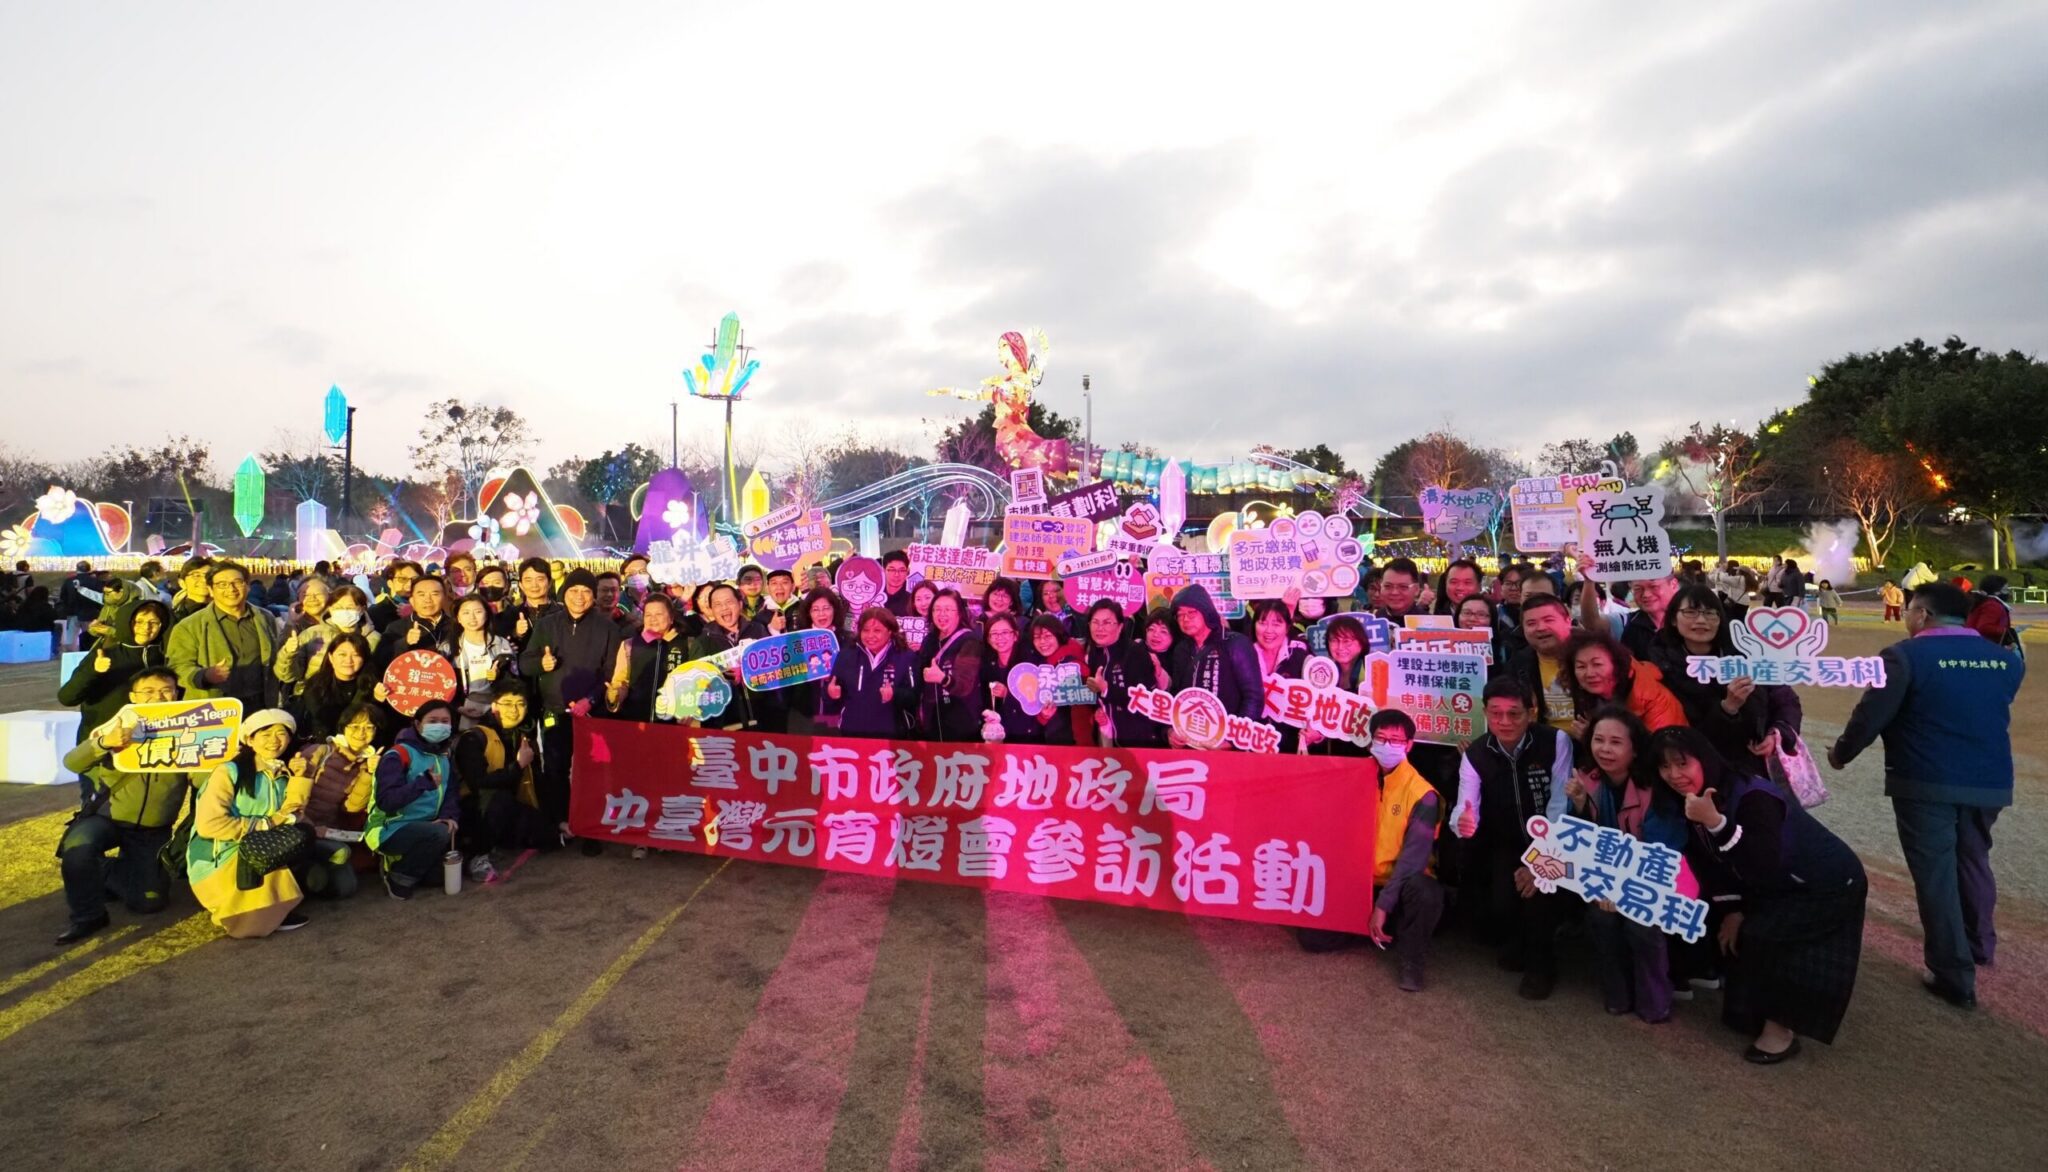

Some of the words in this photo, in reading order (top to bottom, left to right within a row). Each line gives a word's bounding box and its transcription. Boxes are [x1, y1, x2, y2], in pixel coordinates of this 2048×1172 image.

[1560, 474, 1600, 489] Easy
[1051, 485, 1118, 518] 重劃科
[1423, 491, 1493, 509] 清水地政
[1010, 519, 1087, 534] 建物第一次登記
[651, 537, 701, 564] 龍井
[774, 540, 824, 558] 區段徵收
[909, 546, 988, 567] 指定送達處所
[1016, 545, 1044, 557] 辦理
[1234, 539, 1296, 556] 多元繳納
[1593, 535, 1660, 558] 無人機
[680, 559, 736, 584] 地政
[1013, 559, 1048, 573] 最快速
[1239, 555, 1303, 571] 地政規費
[1595, 558, 1661, 574] 測繪新紀元
[1078, 576, 1130, 593] 智慧水湳
[1237, 574, 1266, 587] Easy
[1270, 573, 1293, 587] Pay
[749, 646, 791, 670] 0256
[792, 634, 832, 655] 高風險
[1397, 657, 1478, 675] 埋設土地制式
[1689, 656, 1883, 685] 不動產交易科
[1405, 673, 1471, 690] 界標保權益
[680, 689, 724, 707] 地籍科
[1264, 679, 1371, 738] 大里地政
[1401, 692, 1472, 713] 申請人免
[138, 708, 238, 732] Taichung-Team
[1130, 686, 1172, 721] 大里
[1228, 717, 1279, 753] 地政
[1411, 713, 1472, 736] 備界標
[690, 735, 1209, 821] 臺中市政府地政局
[601, 787, 1326, 917] 中臺灣元宵燈會參訪活動
[1556, 817, 1678, 888] 不動產
[1579, 866, 1705, 940] 交易科
